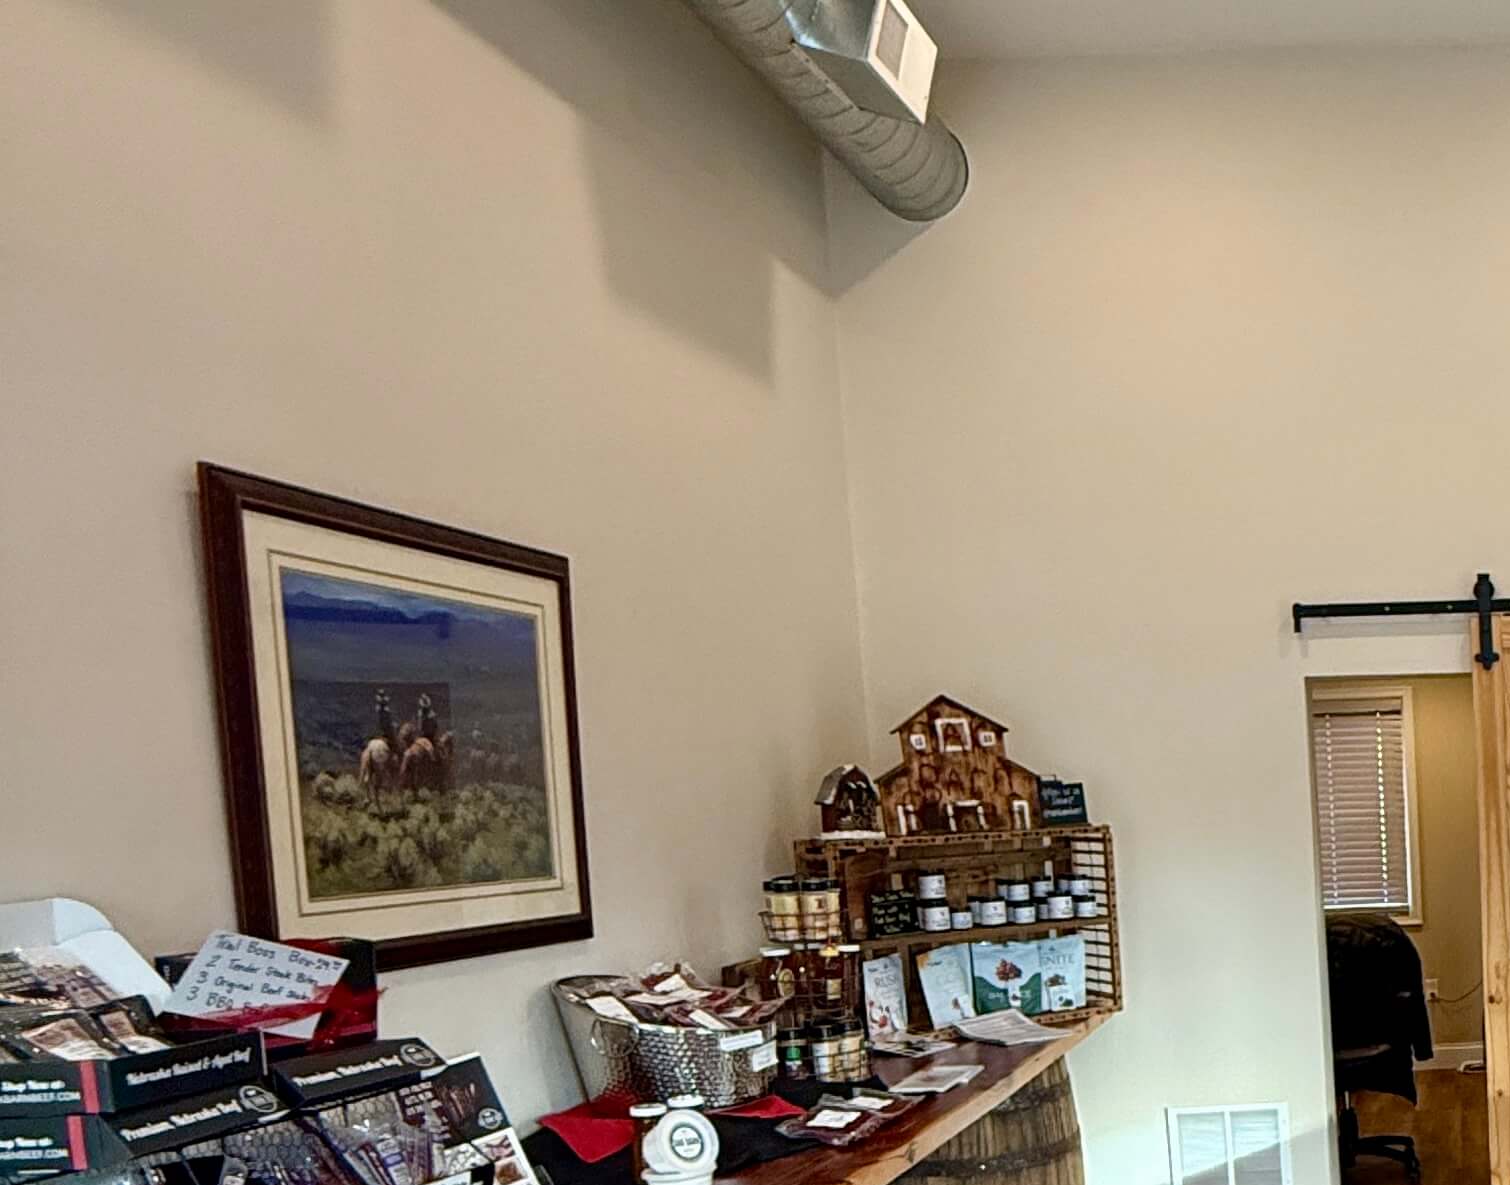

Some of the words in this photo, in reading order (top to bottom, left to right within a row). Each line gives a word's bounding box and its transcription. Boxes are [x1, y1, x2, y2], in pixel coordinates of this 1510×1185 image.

[205, 955, 221, 968] 2
[197, 971, 209, 984] 3
[186, 986, 199, 1001] 3
